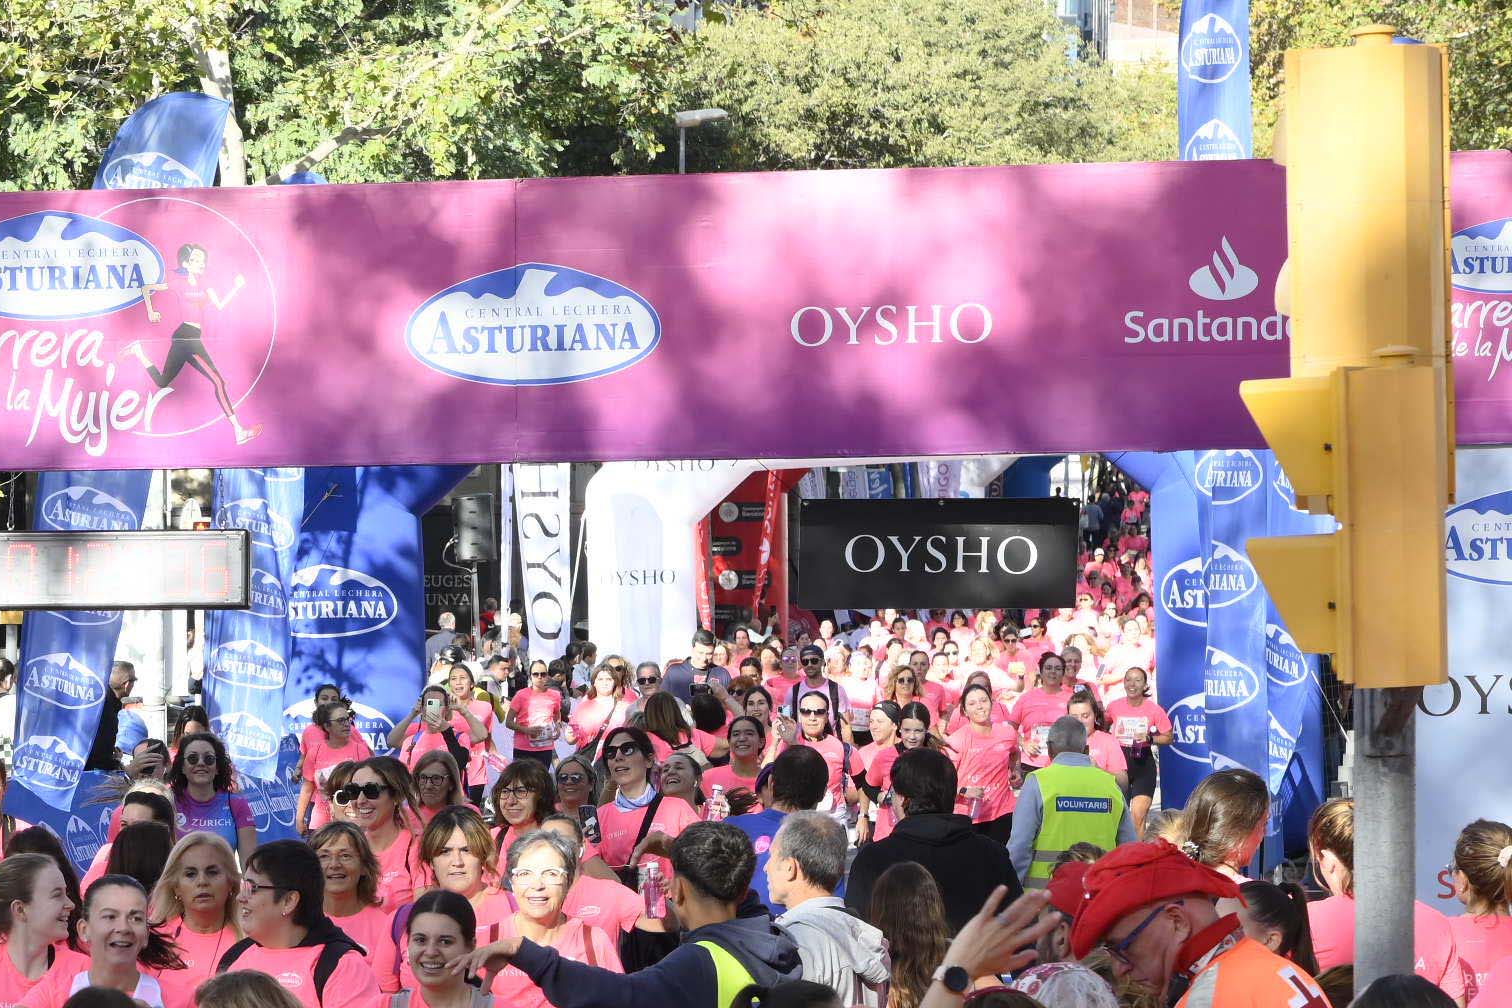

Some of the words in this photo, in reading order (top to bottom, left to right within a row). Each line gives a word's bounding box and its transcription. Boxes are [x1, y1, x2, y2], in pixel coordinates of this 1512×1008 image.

[68, 246, 140, 259] LECHERA
[465, 304, 544, 319] CENTRAL
[552, 303, 633, 317] LECHERA
[790, 302, 993, 348] OYSHO
[428, 310, 641, 356] ASTURIANA
[1124, 309, 1291, 345] Santand
[5, 371, 32, 411] la
[26, 361, 175, 456] Mujer
[844, 534, 1039, 575] OYSHO
[335, 588, 384, 599] LECHERA
[289, 600, 389, 621] STURIANA
[1417, 674, 1512, 717] OY
[1057, 800, 1108, 810] VOLUNTARIS
[191, 818, 232, 828] ZURICH
